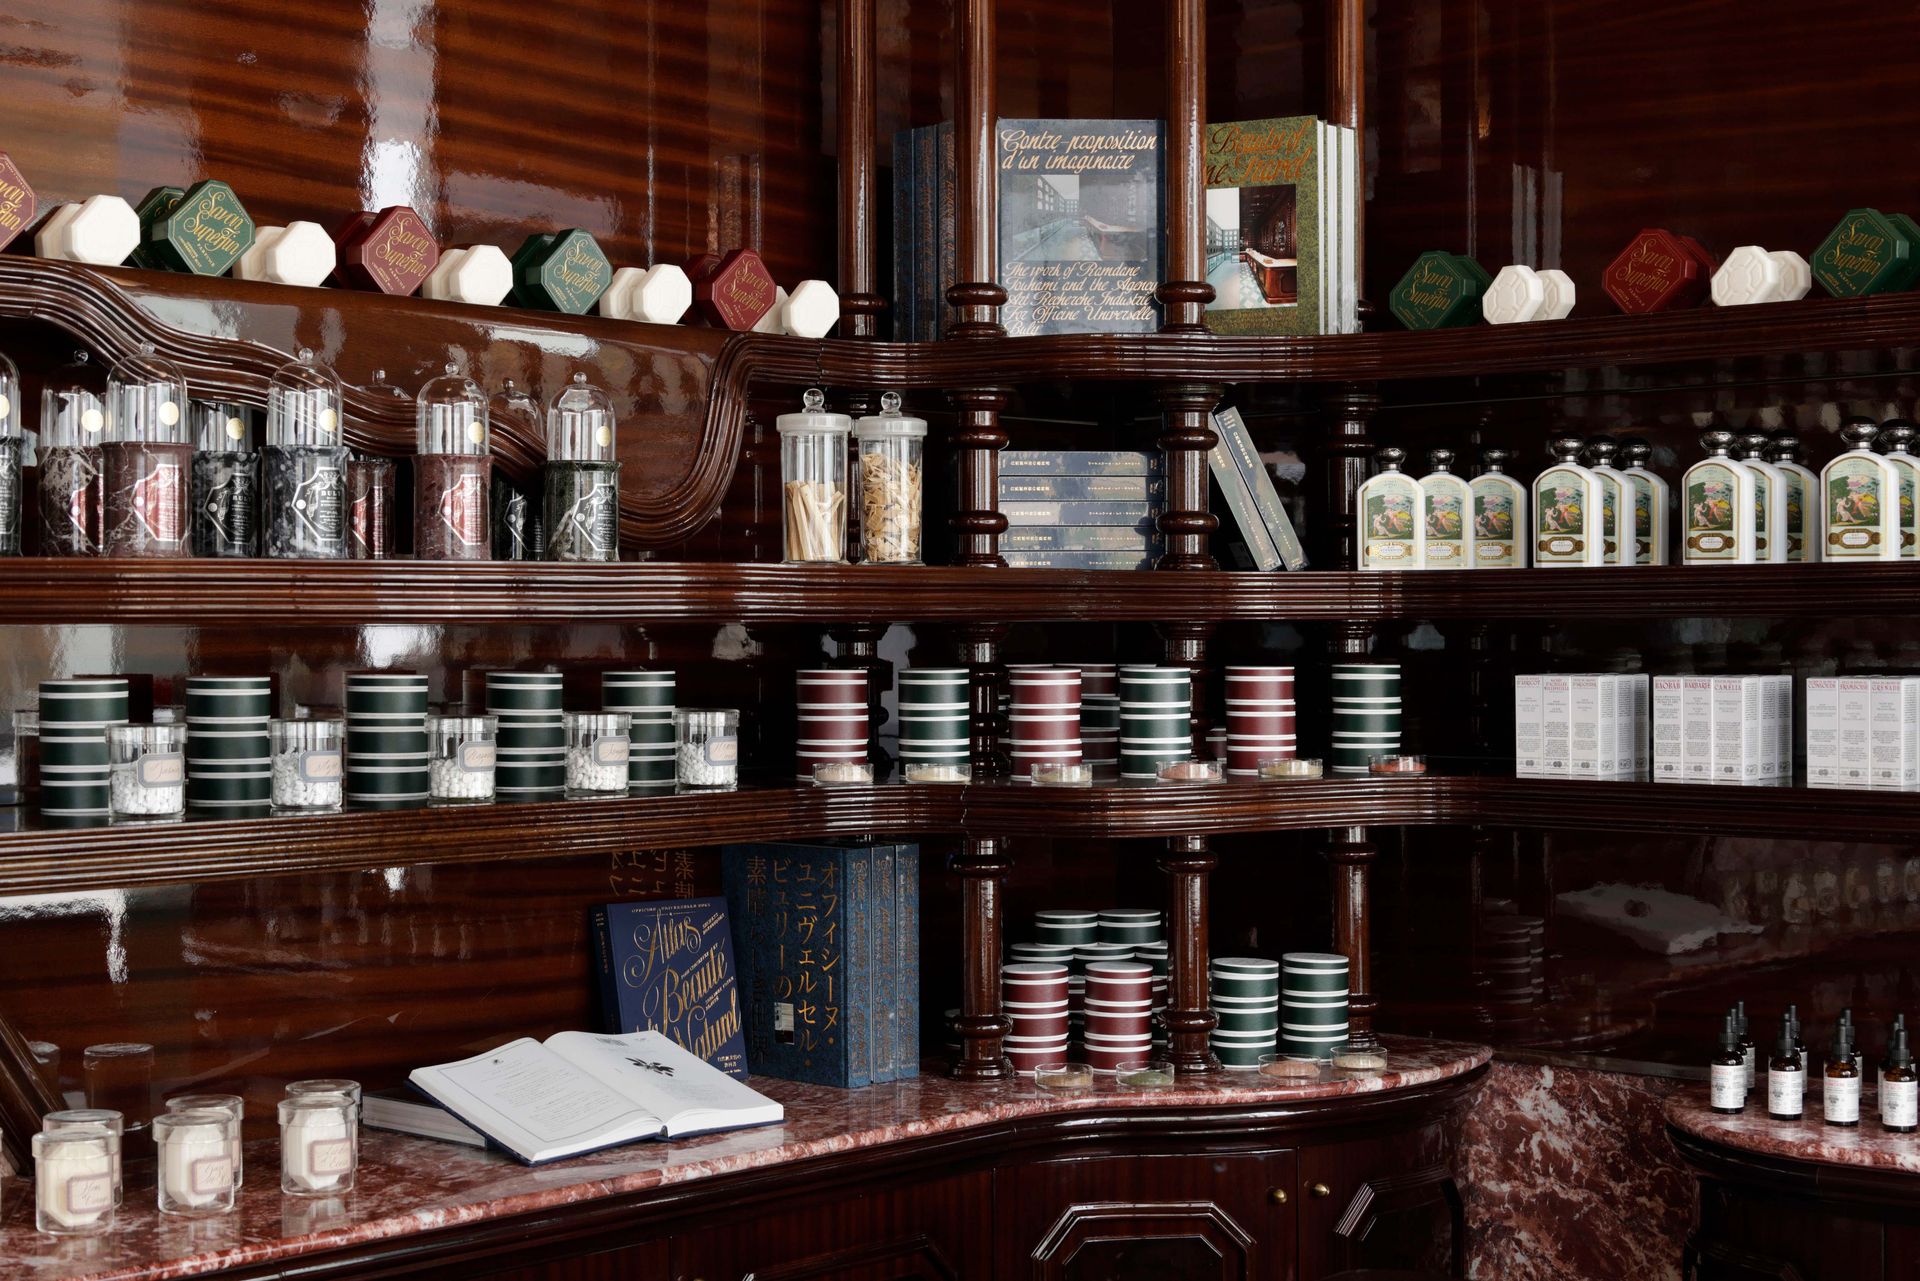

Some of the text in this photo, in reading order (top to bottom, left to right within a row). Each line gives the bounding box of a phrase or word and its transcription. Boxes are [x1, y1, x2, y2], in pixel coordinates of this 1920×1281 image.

[1210, 119, 1312, 155] Beauty of
[1001, 150, 1134, 173] d'un imaginaire
[199, 189, 244, 230] Savon
[389, 215, 430, 253] Savon
[1003, 262, 1141, 278] The work of Ramdane
[1006, 277, 1158, 294] Touhami and the Agency
[1003, 306, 1153, 321] For Officine Universelle
[1006, 293, 1029, 307] Art
[624, 908, 701, 988] Atlas
[642, 938, 728, 1038] Beauté
[674, 987, 742, 1062] Naturel
